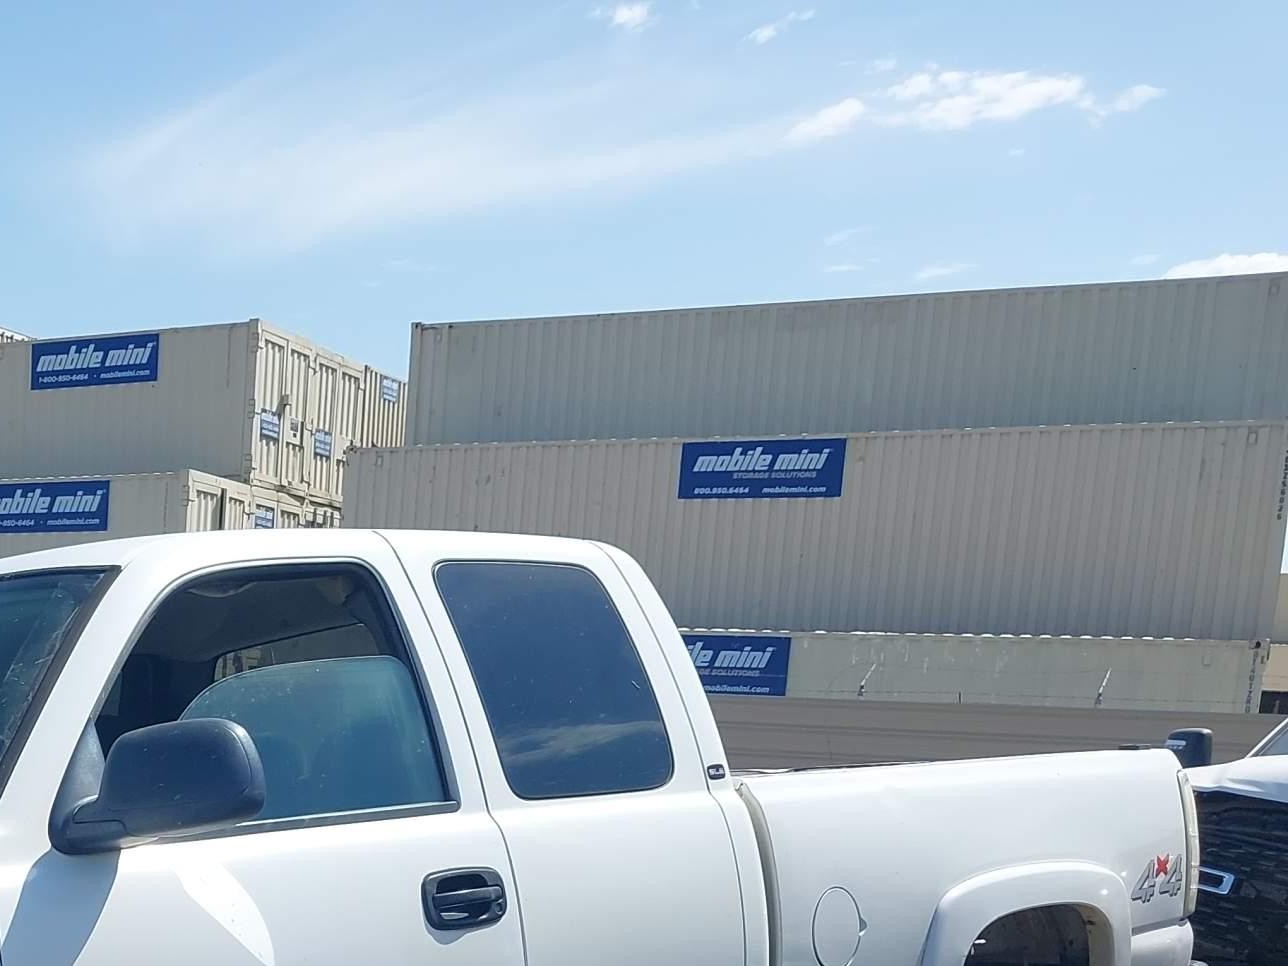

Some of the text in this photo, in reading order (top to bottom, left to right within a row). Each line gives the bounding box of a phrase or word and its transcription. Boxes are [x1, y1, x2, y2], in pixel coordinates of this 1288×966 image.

[36, 342, 152, 372] mobile mini
[693, 447, 830, 472] mobile mini
[52, 490, 103, 513] mini
[714, 646, 774, 668] mini
